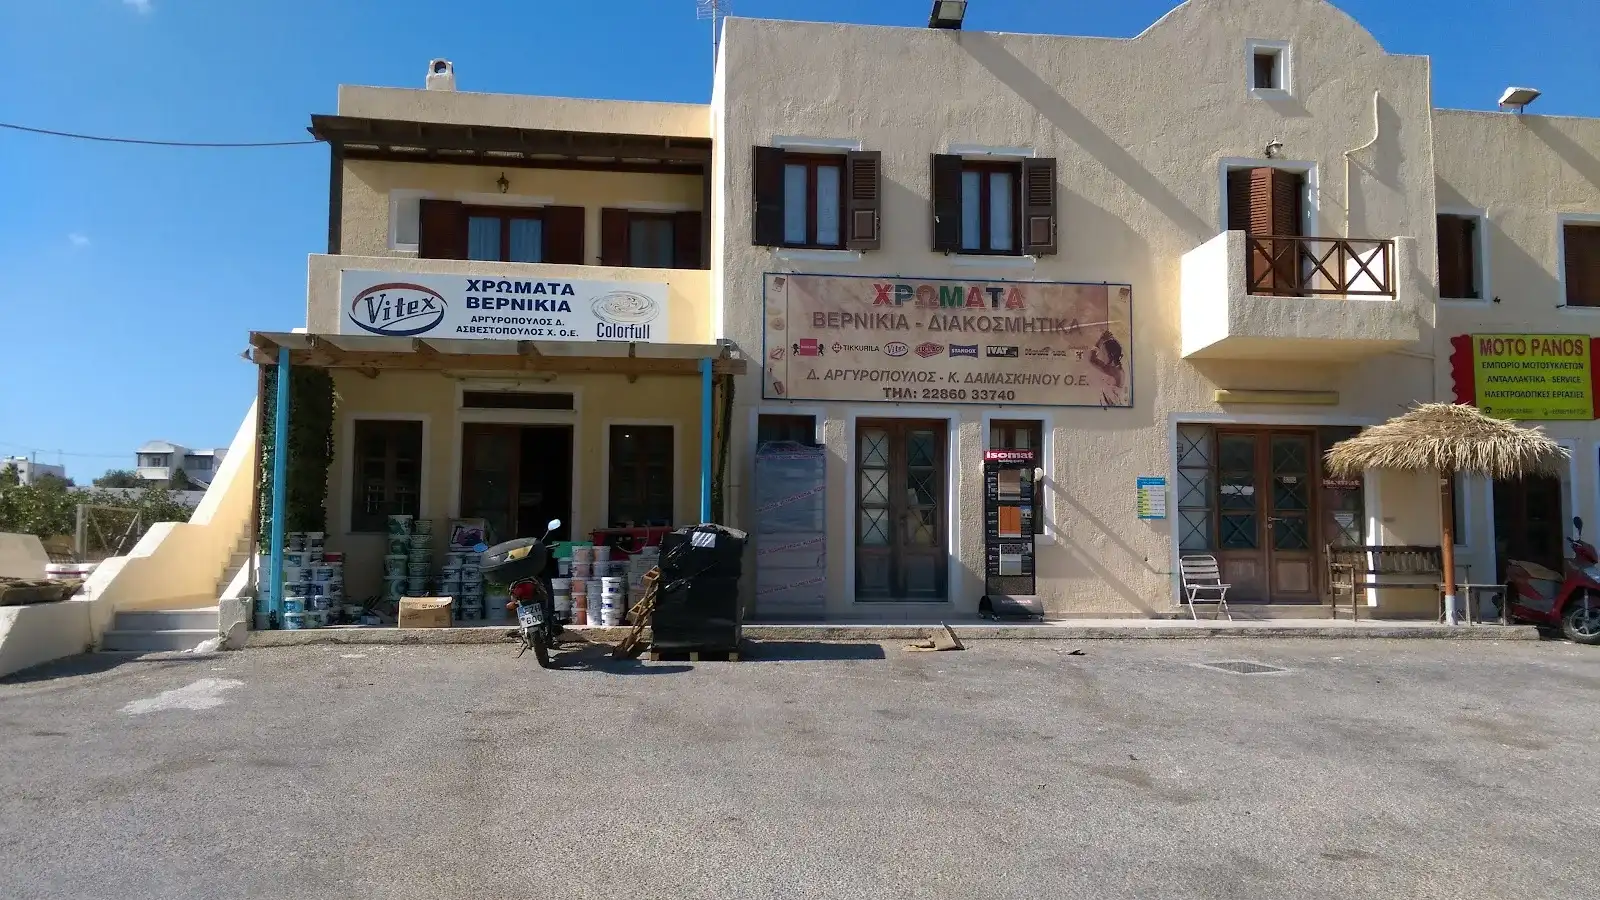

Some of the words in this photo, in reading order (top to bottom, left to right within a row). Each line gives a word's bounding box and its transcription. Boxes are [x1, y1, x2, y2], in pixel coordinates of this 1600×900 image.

[466, 279, 575, 296] ΧΡΩΜΑΤΑ
[873, 283, 1026, 310] ΧΡΩΜΑΤΑ
[364, 292, 437, 324] Vitex
[466, 297, 572, 313] ΒΕΡΝΙΚΙΑ
[471, 315, 554, 326] ΑΡΓΥΡΟΠΟΥΛΟΣ
[556, 318, 565, 327] Δ.
[812, 311, 910, 330] ΒΕΡΝΙΚΙΑ
[927, 313, 1081, 335] ΔΙΑΚΟΣΜΗΤΙΚΑ
[456, 325, 544, 337] ΑΣΒΕΣΤΟΠΟΥΛΟΣ
[546, 328, 556, 337] Χ.
[559, 329, 579, 338] Ο.Ε.
[596, 322, 650, 339] Colorfull
[843, 344, 880, 352] TIKKURILA
[1480, 338, 1527, 356] MOTO
[1531, 338, 1584, 357] PANOS
[1482, 361, 1520, 369] ΕΜΠΟΡΙΟ
[807, 368, 820, 381] Δ.
[824, 369, 937, 383] ΑΡΓΥΡΟΠΟΥΛΟΣ
[948, 371, 961, 384] Κ.
[964, 372, 1062, 386] ΔΑΜΑΣΚΗΝΟΥ
[1064, 374, 1089, 386] Ο.Ε.
[883, 387, 918, 400] ΤΗΛ:
[922, 388, 967, 400] 22860
[971, 389, 1015, 401] 33740
[986, 451, 1034, 459] isomat
[526, 614, 543, 625] 600
